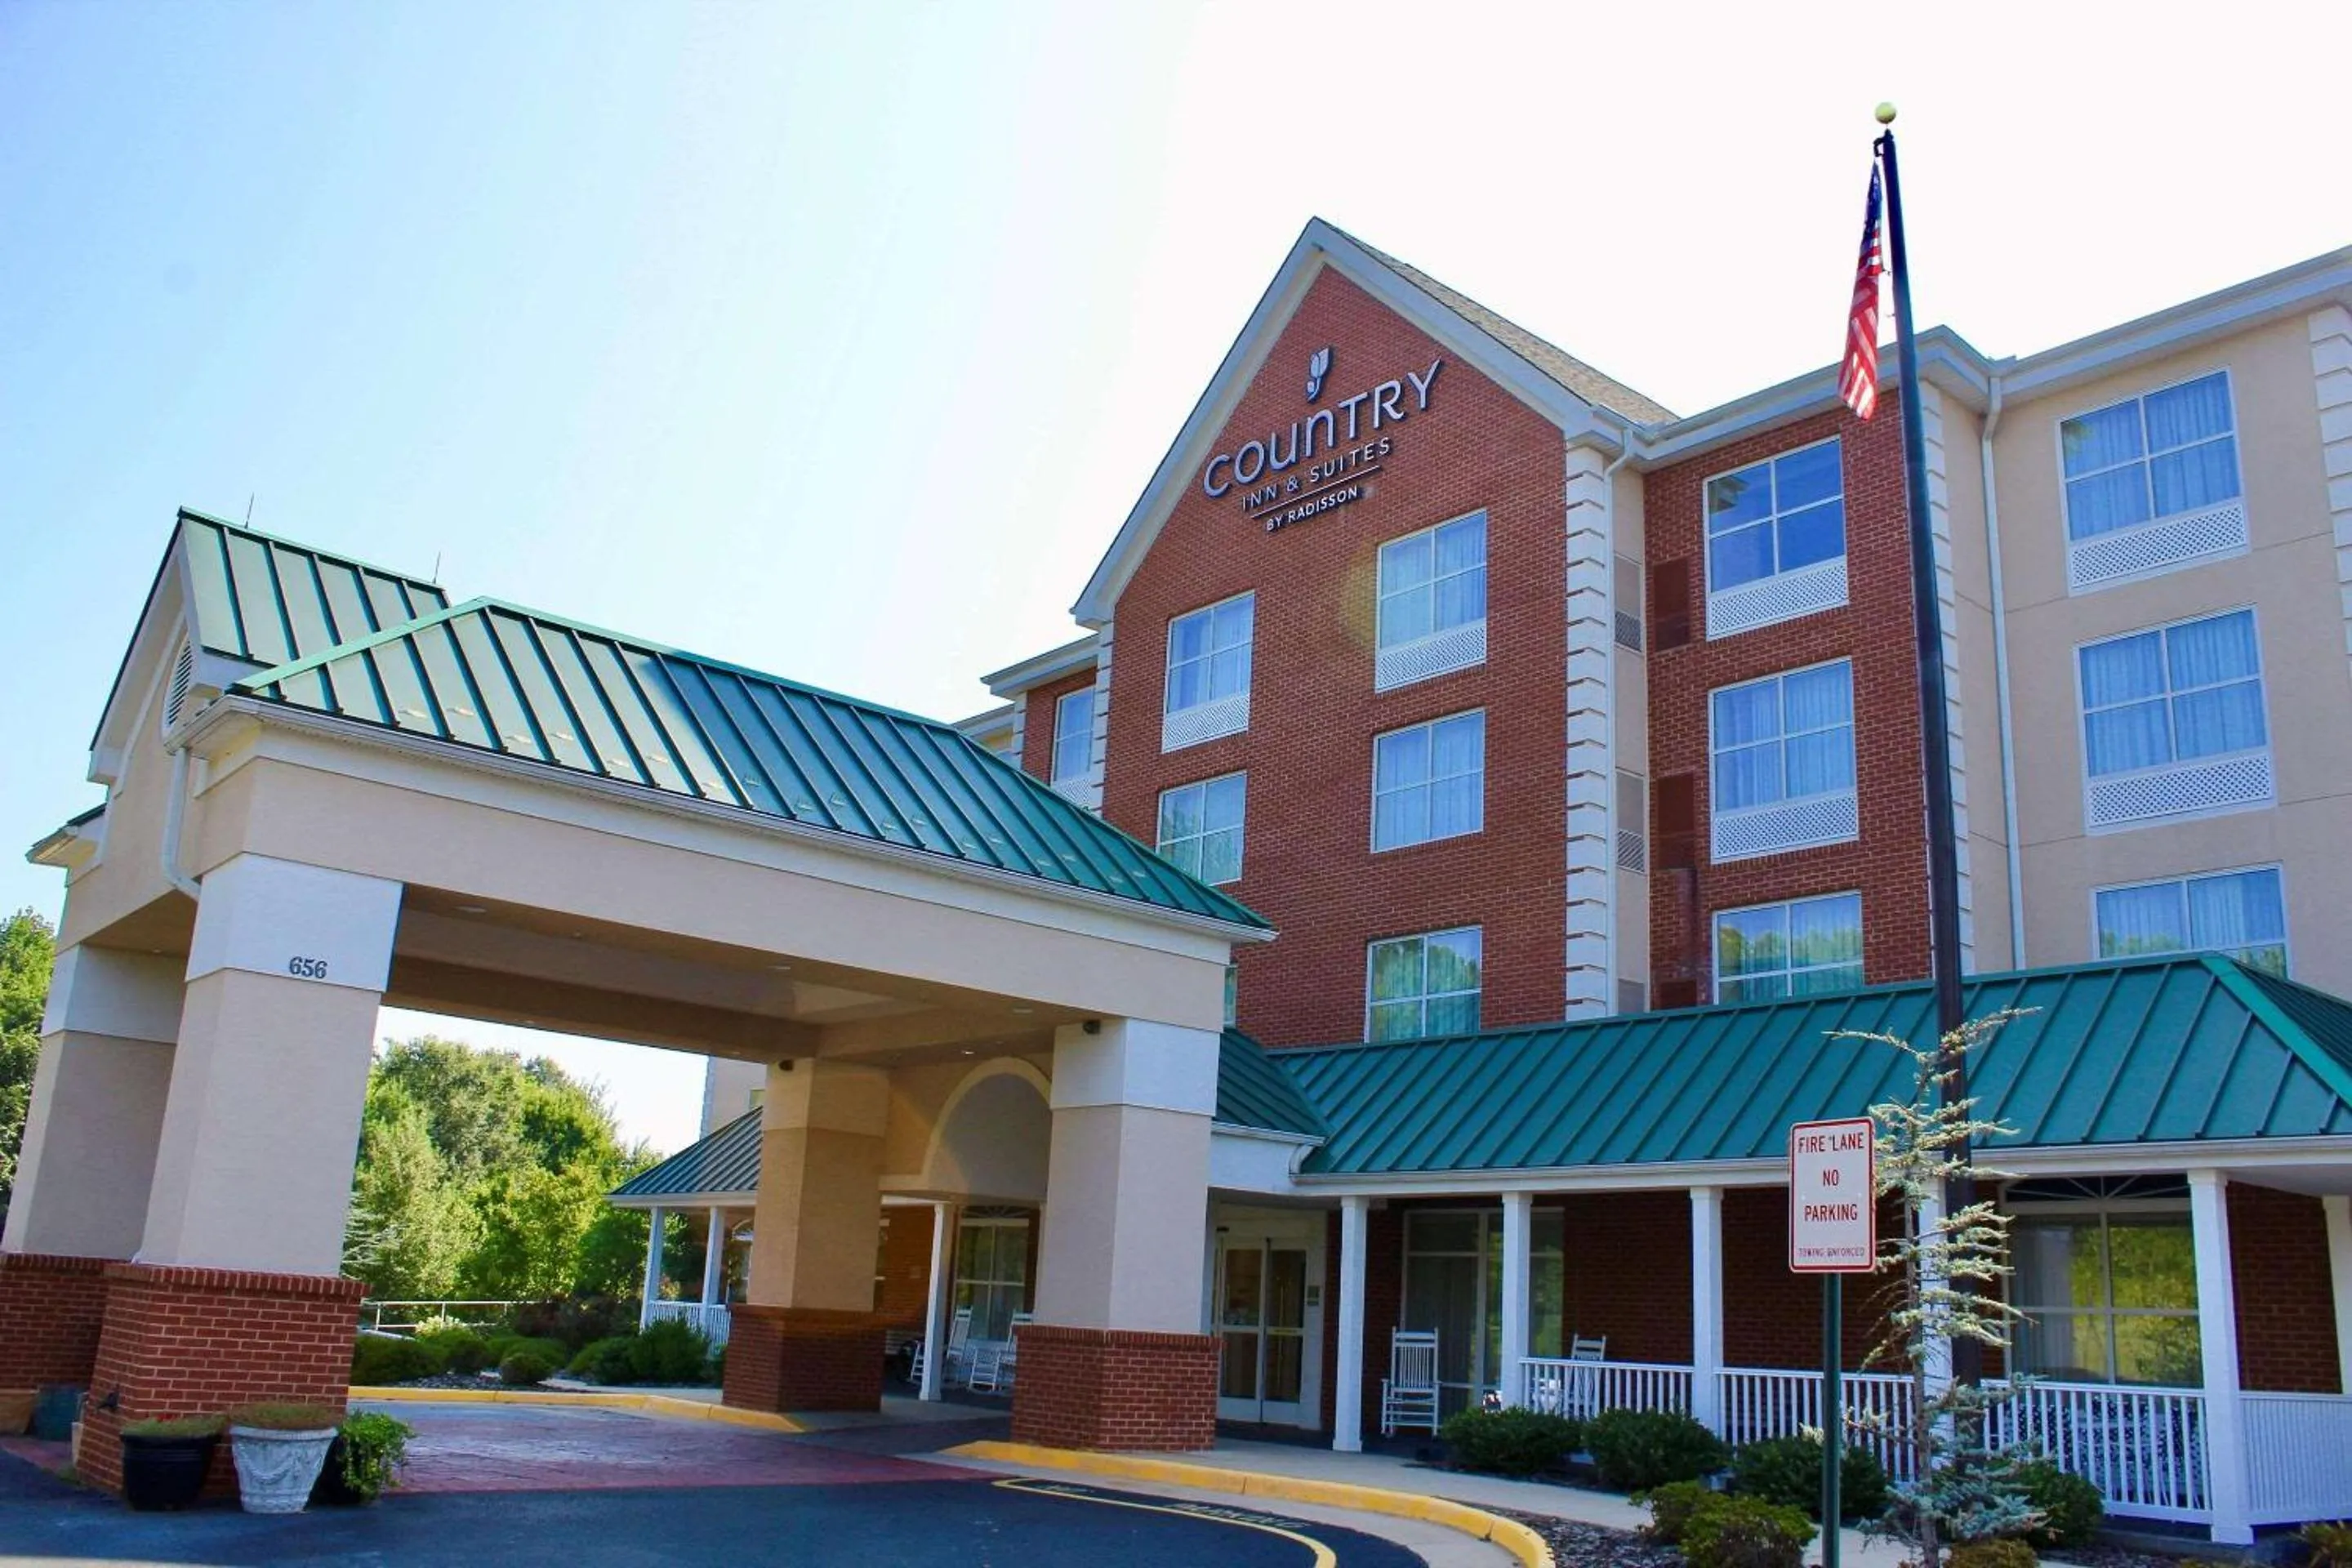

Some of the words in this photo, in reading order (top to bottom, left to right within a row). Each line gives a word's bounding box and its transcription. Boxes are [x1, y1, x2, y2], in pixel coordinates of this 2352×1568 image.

[1242, 483, 1277, 511] INN
[1286, 474, 1300, 492] &
[1309, 437, 1391, 483] SUITES
[1266, 515, 1284, 532] BY
[1287, 484, 1358, 523] RADISSON
[288, 956, 328, 979] 656
[1797, 1135, 1826, 1153] FIRE
[1832, 1132, 1865, 1152] LANE
[1823, 1169, 1840, 1187] NO
[1804, 1203, 1858, 1222] PARKING
